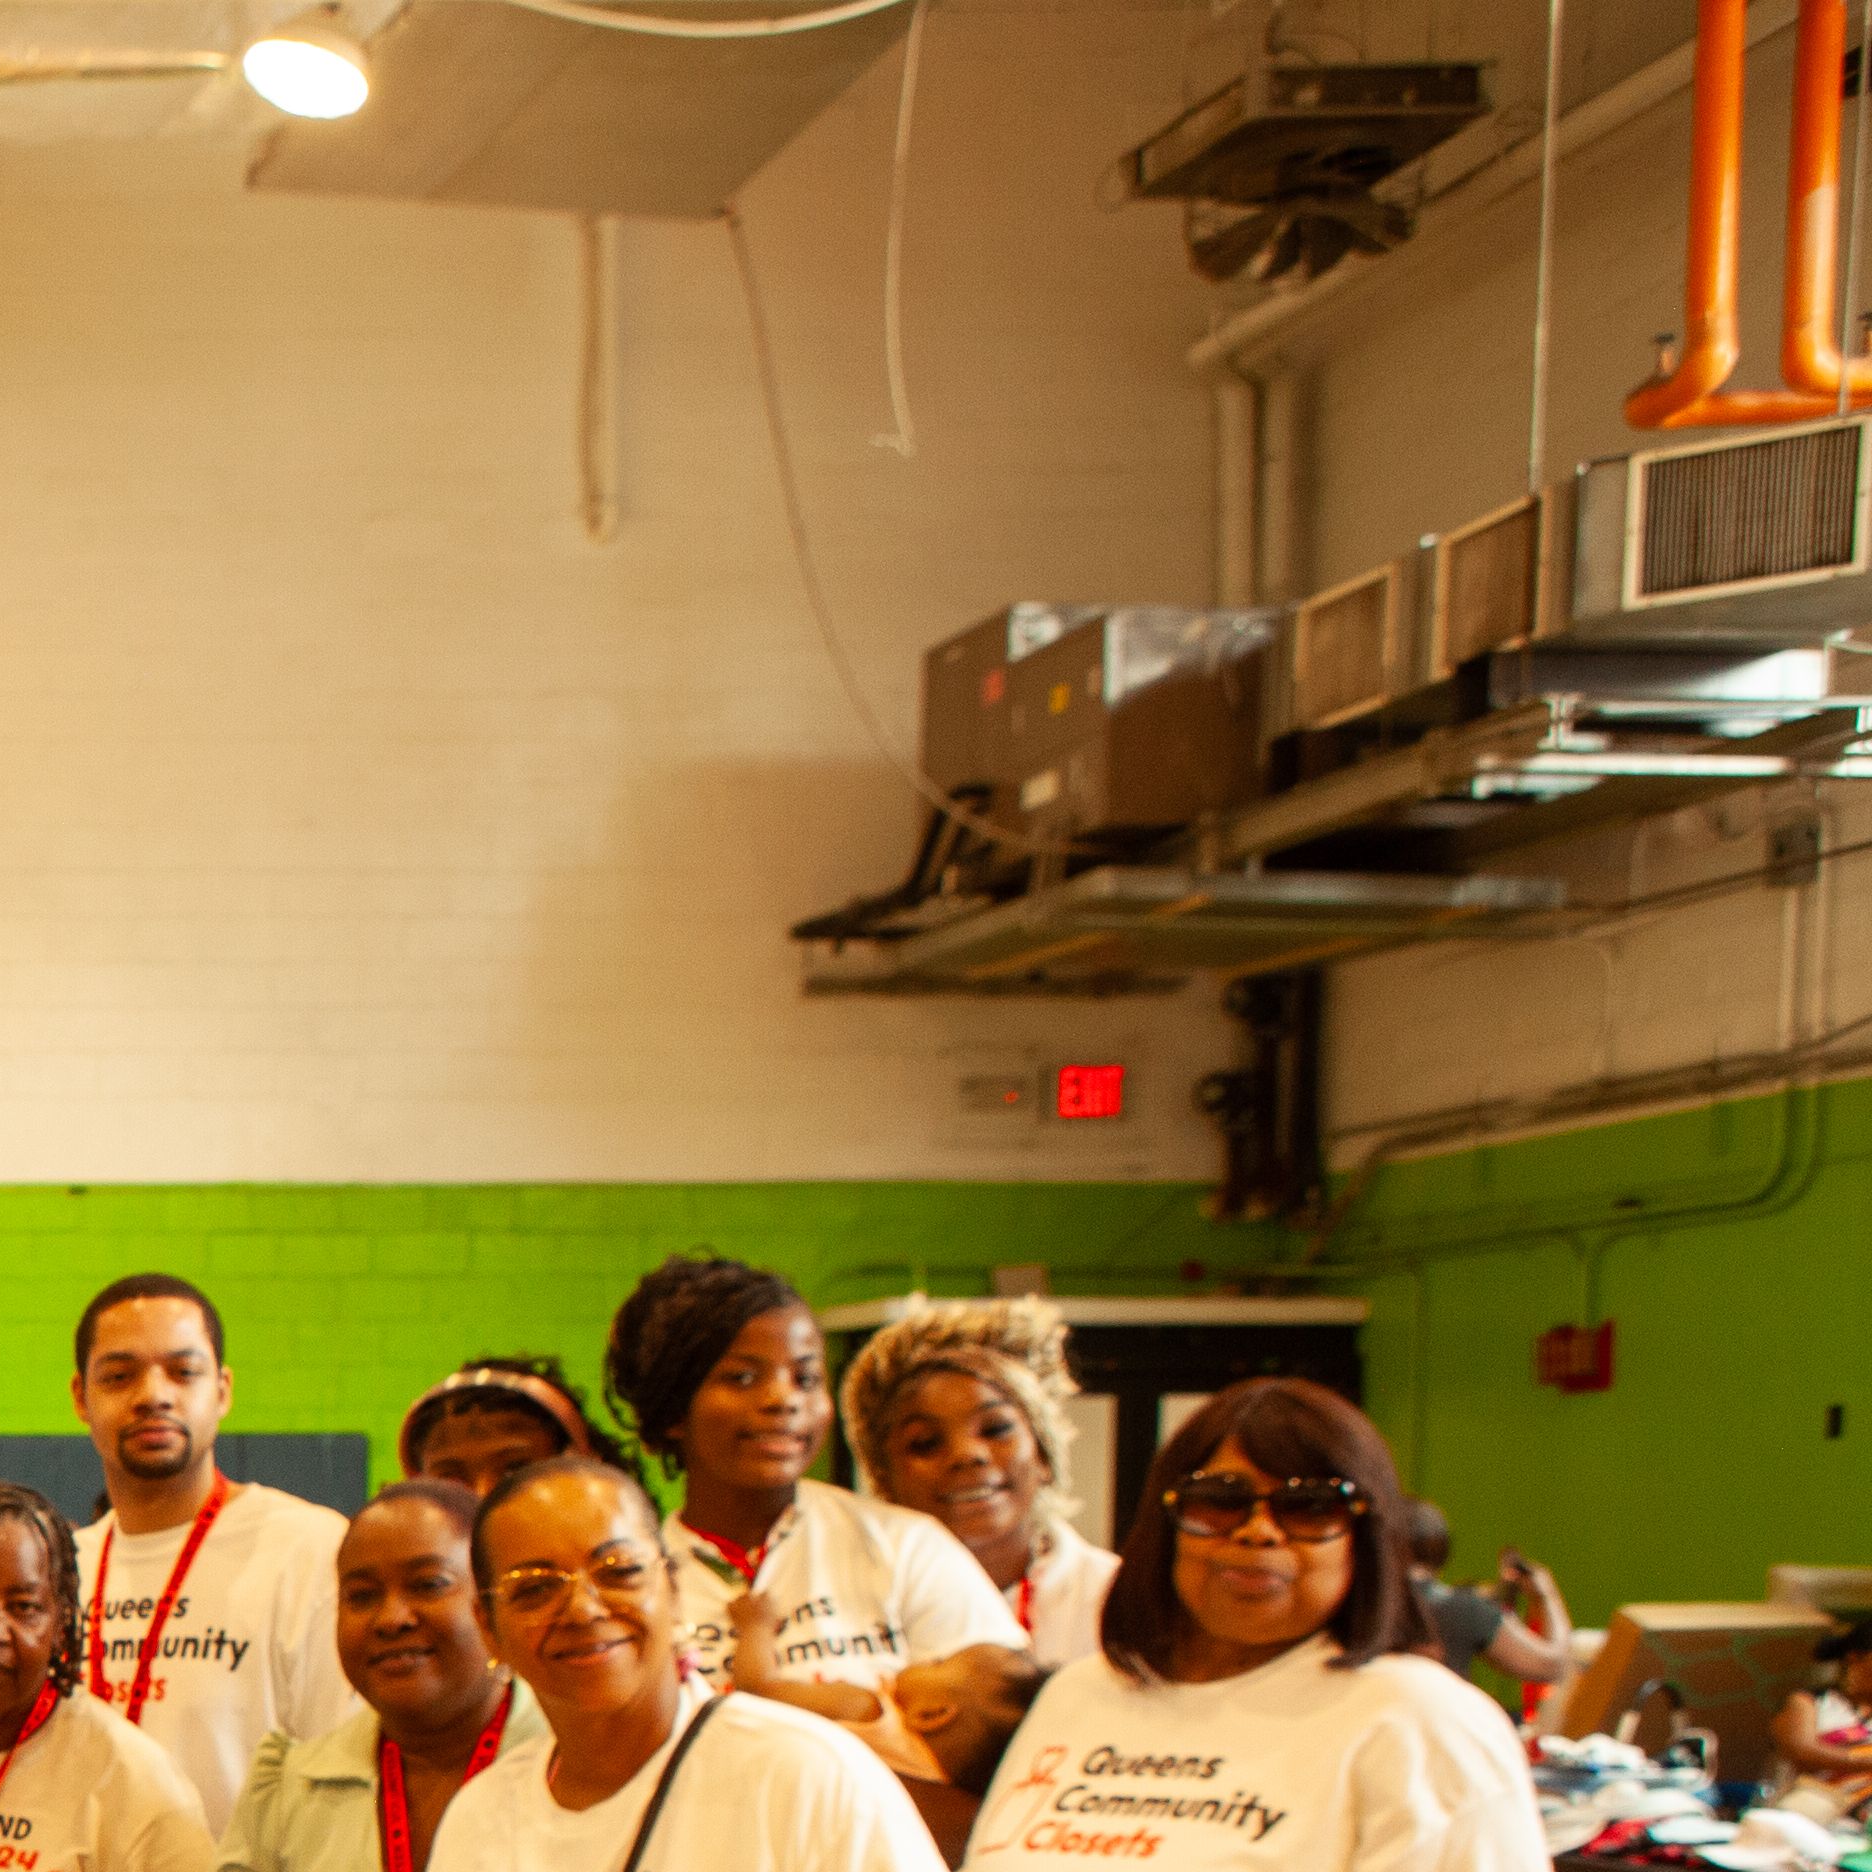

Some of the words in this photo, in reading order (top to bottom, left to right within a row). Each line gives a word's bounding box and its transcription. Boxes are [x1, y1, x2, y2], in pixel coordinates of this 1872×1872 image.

[1081, 1744, 1226, 1780] Queens
[1055, 1784, 1288, 1843] Community
[1023, 1818, 1164, 1859] Closets
